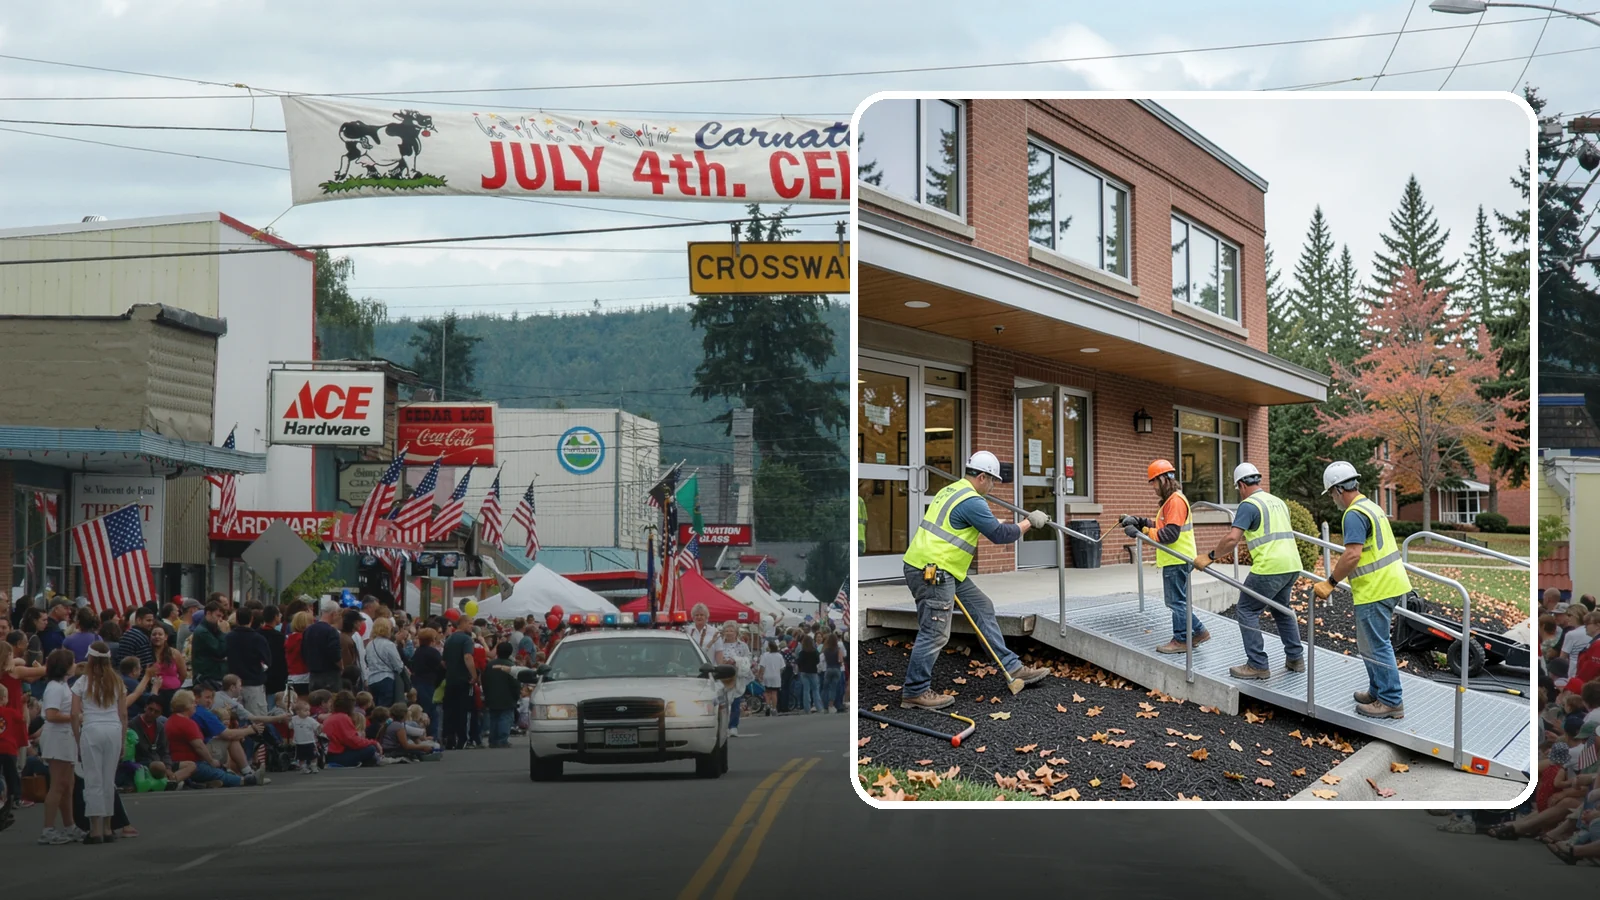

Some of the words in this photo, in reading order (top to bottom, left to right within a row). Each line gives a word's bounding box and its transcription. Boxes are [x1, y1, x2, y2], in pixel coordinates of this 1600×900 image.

[694, 121, 850, 149] Carnat
[481, 141, 604, 193] JULY
[632, 150, 746, 198] 4th.
[697, 254, 850, 280] CROSSWA
[283, 380, 373, 420] ACE
[405, 409, 452, 421] CEDAR
[461, 409, 485, 421] LOG
[284, 421, 371, 436] Hardware
[416, 428, 478, 447] Coca-Cola
[353, 467, 385, 480] Simpl
[95, 485, 124, 494] Vincent
[126, 486, 136, 495] de
[137, 486, 155, 495] Paul
[80, 503, 154, 522] THT
[213, 516, 331, 535] HARDARE
[688, 526, 741, 535] CRNATION
[699, 535, 730, 543] GLASS
